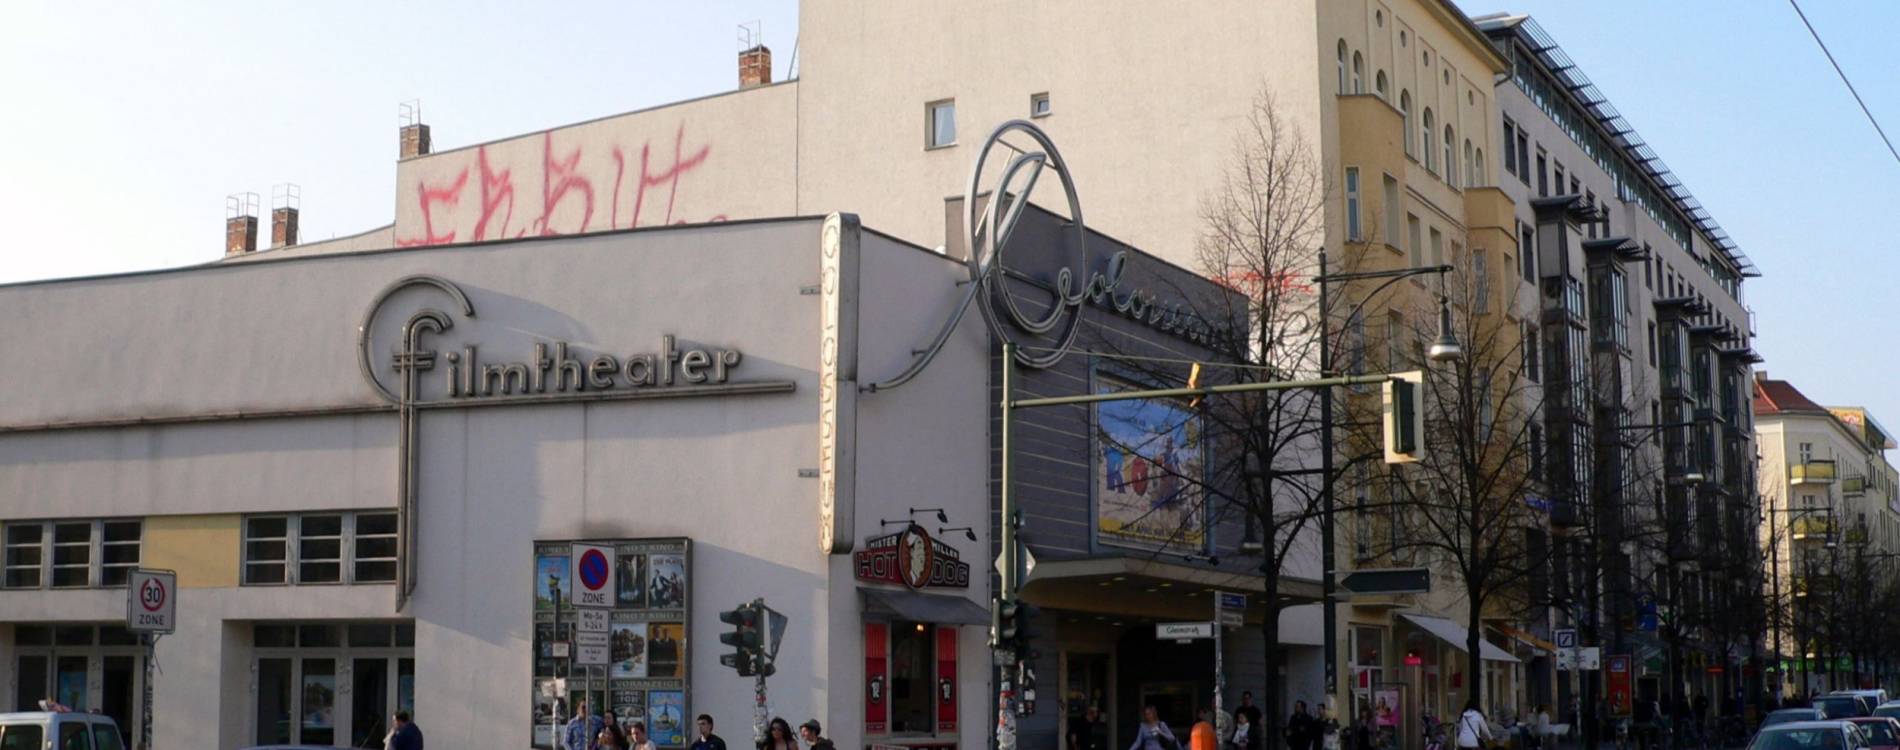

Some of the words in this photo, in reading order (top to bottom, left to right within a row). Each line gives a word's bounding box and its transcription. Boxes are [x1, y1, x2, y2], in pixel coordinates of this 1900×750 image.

[869, 535, 898, 549] MISTER
[932, 541, 959, 558] MILLER
[856, 551, 898, 580] HOT
[931, 556, 969, 586] DOG
[144, 586, 160, 602] 30
[582, 593, 605, 604] ZONE
[139, 614, 164, 626] ZONE
[615, 680, 680, 688] VORANZEIGE
